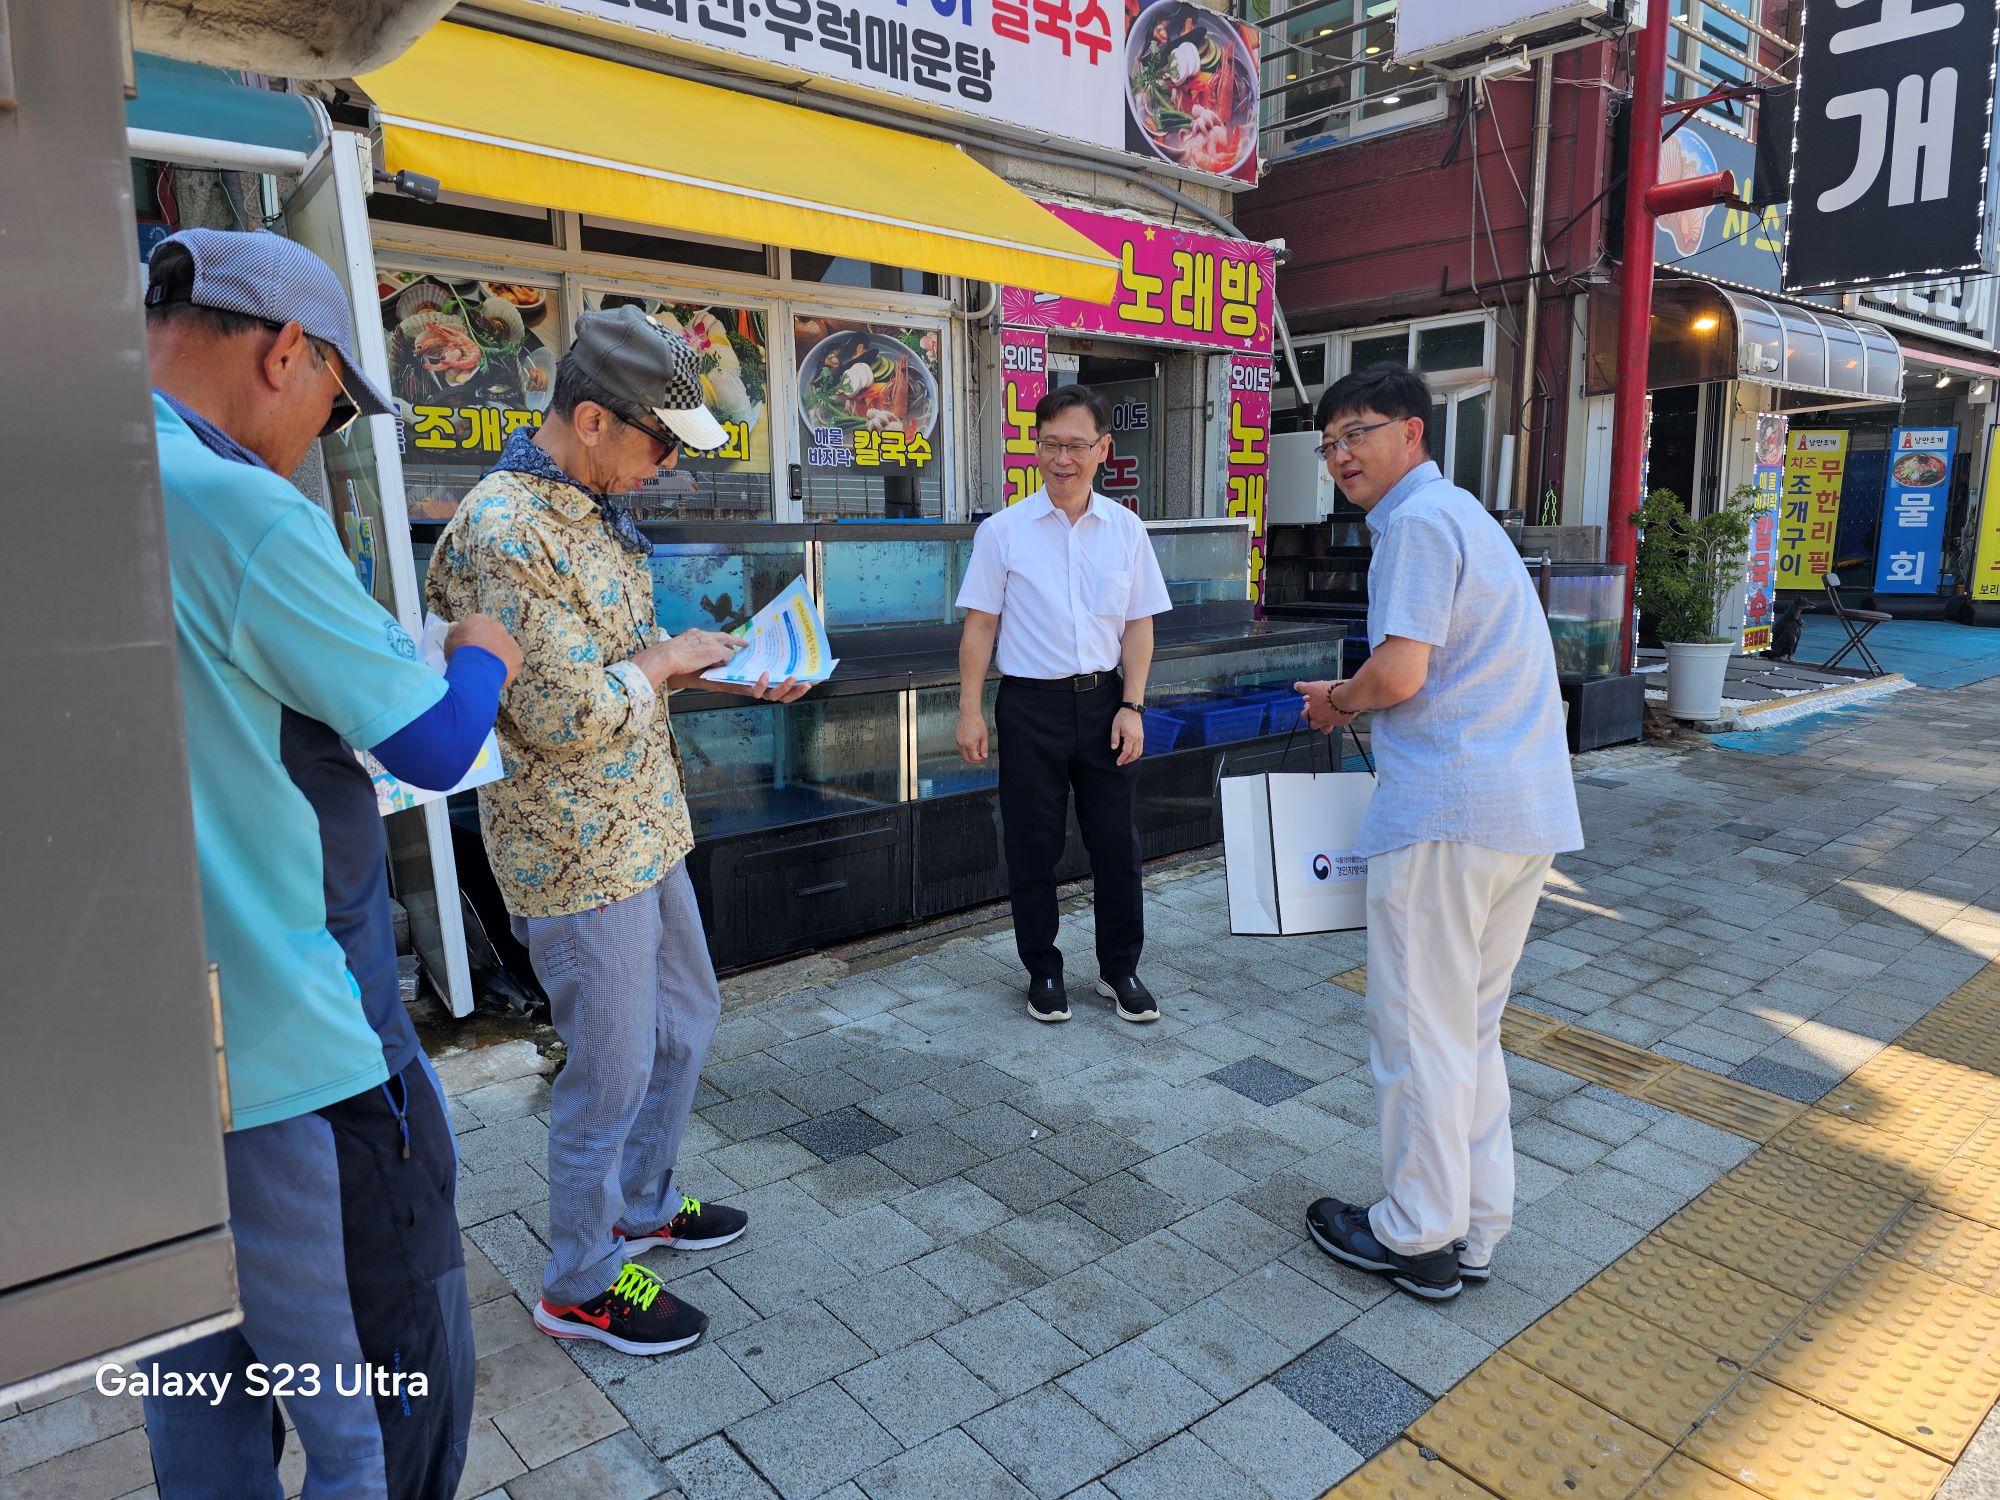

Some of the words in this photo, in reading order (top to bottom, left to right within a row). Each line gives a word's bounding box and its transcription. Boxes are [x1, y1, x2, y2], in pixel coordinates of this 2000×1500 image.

[1118, 240, 1262, 337] 노래방
[1004, 344, 1044, 372] 오이도
[1231, 364, 1271, 392] 오이도
[1110, 402, 1149, 432] 이도
[814, 427, 843, 446] 해물
[853, 430, 933, 468] 칼국수
[1808, 438, 1838, 447] 낭만조개
[1914, 435, 1945, 445] 낭만조개
[807, 447, 851, 467] 바지락
[1790, 456, 1818, 469] 치즈
[1779, 474, 1812, 576] 조개구이
[1807, 459, 1843, 575] 무한리필
[1886, 493, 1935, 585] 물회
[1748, 515, 1773, 624] 칼국수
